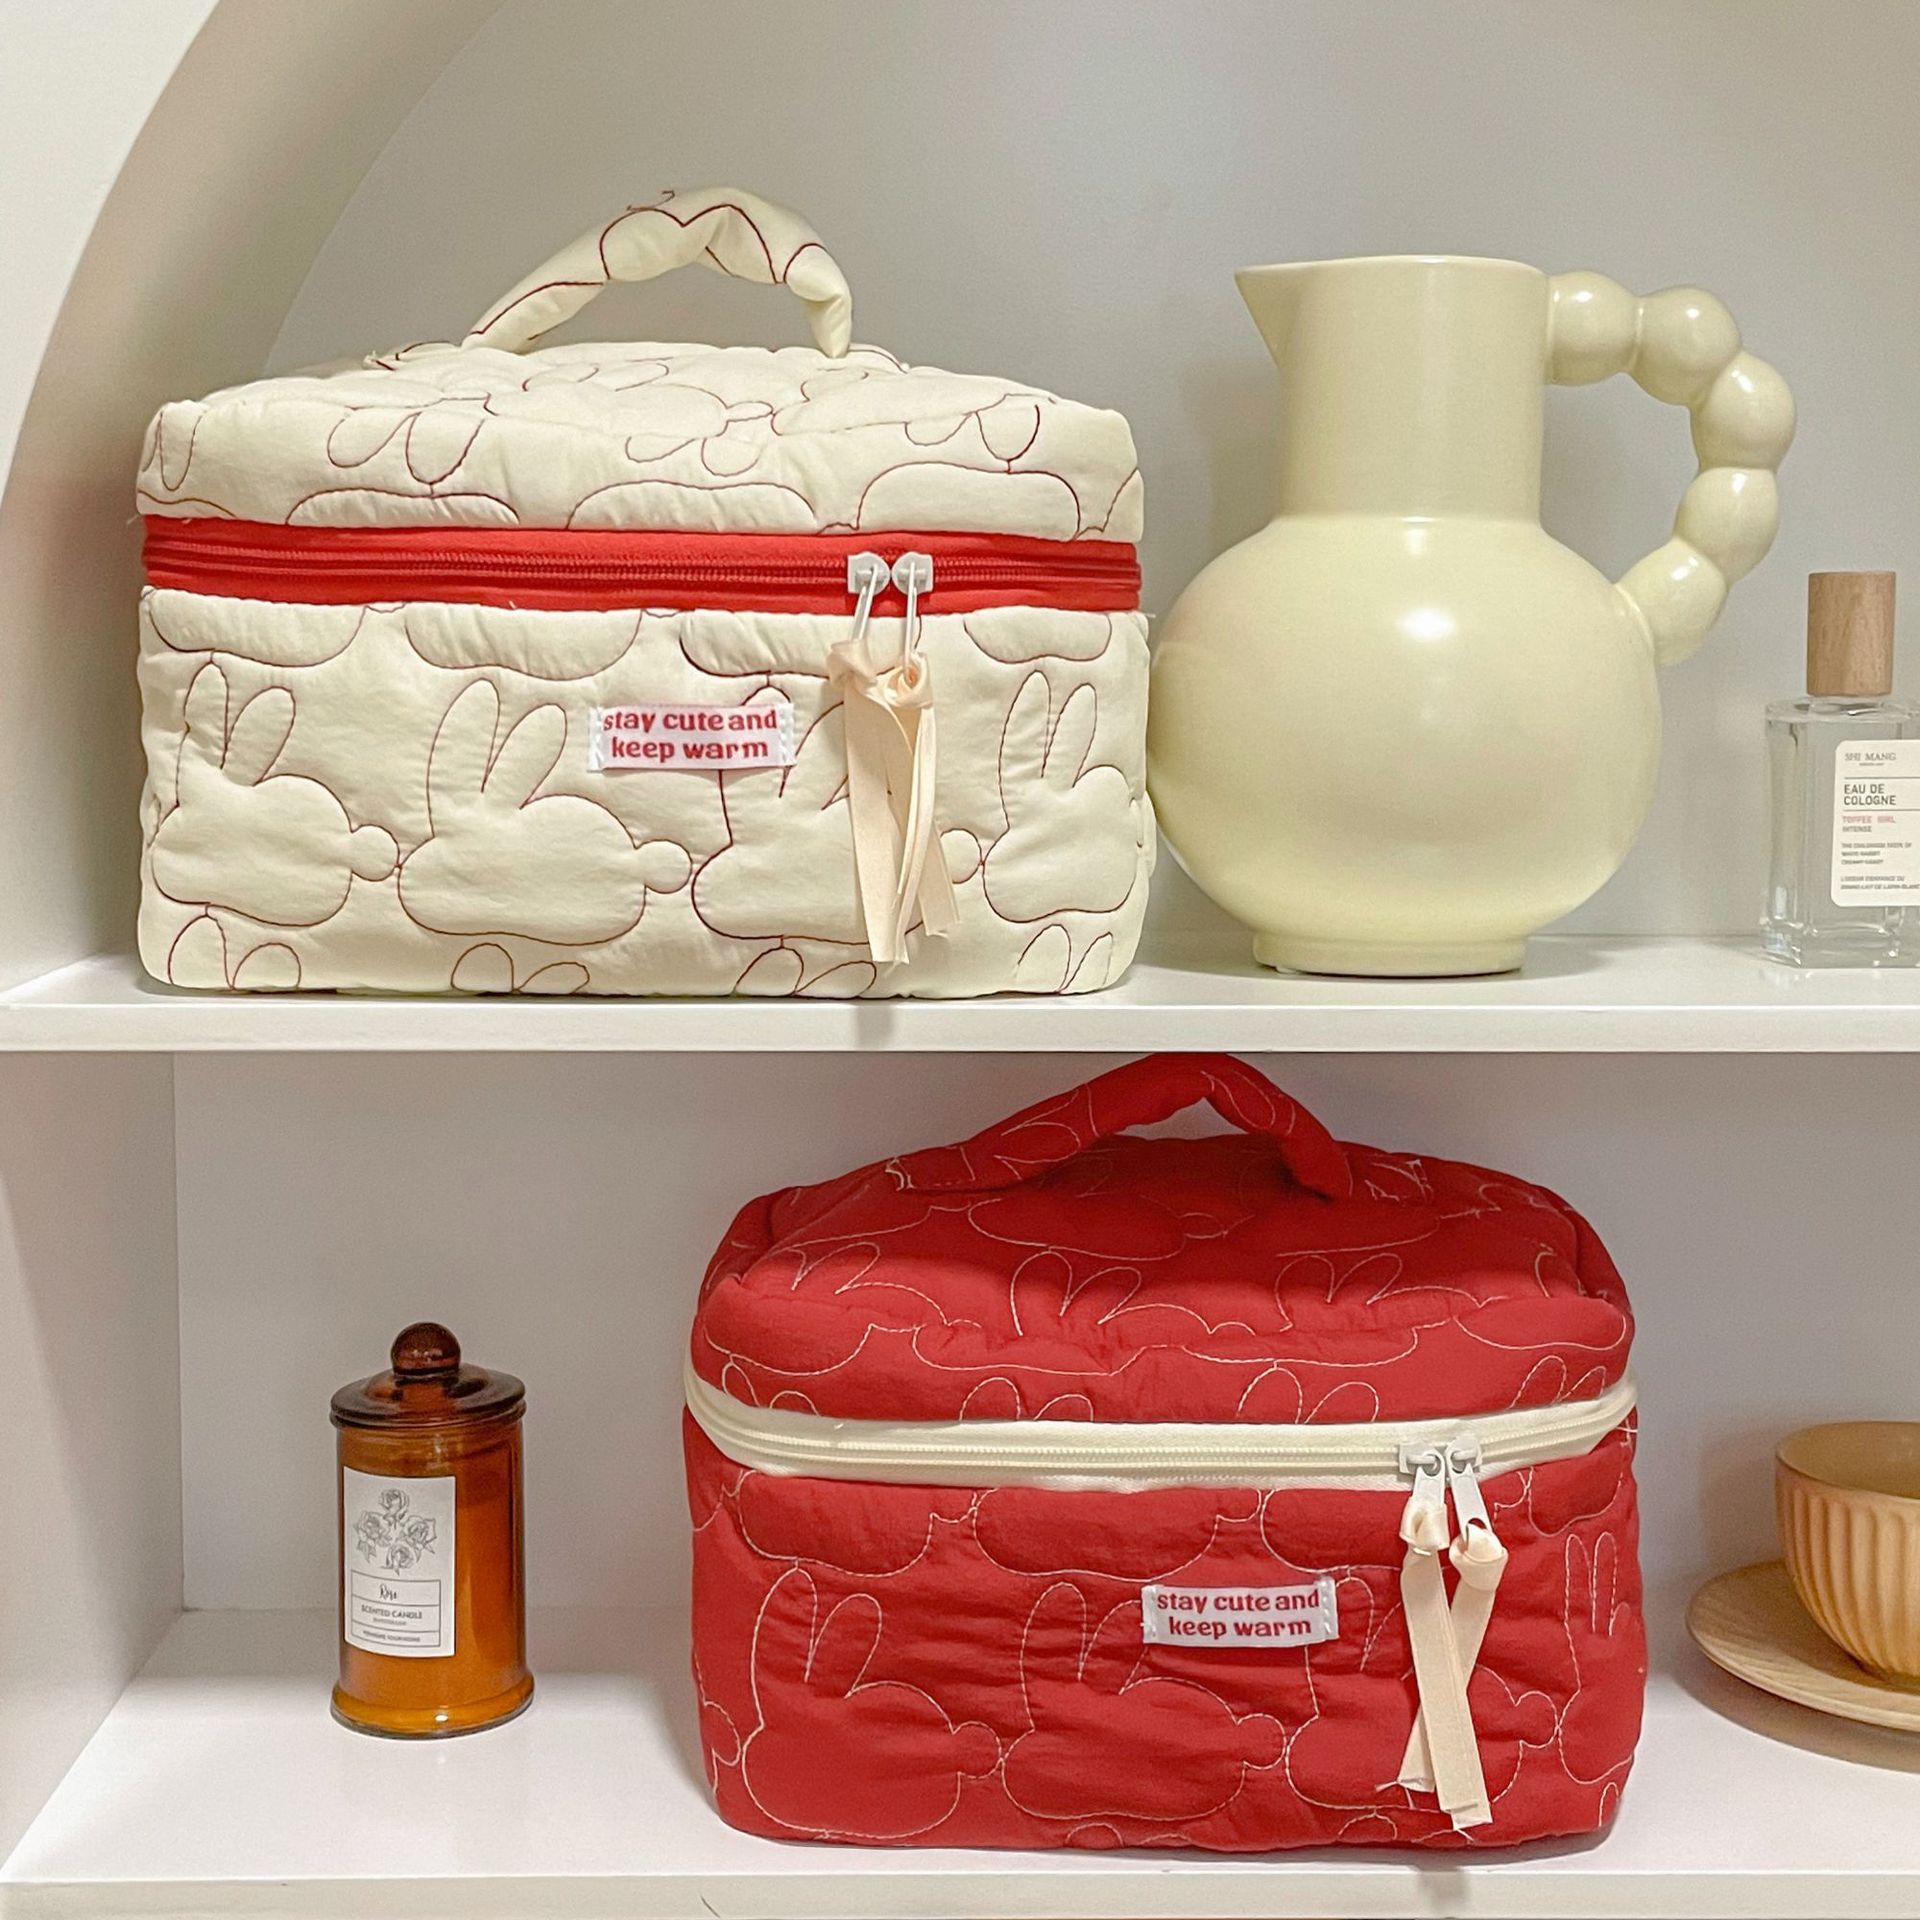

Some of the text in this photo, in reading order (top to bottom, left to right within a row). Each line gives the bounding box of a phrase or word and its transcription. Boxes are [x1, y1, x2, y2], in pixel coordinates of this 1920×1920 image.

[604, 709, 778, 733] stay cute and
[611, 736, 769, 763] keep warm
[1843, 795, 1897, 806] COLOGNE
[1844, 784, 1885, 795] EAU DE
[1157, 1589, 1320, 1614] stay cute and
[1168, 1616, 1312, 1640] keep warm
